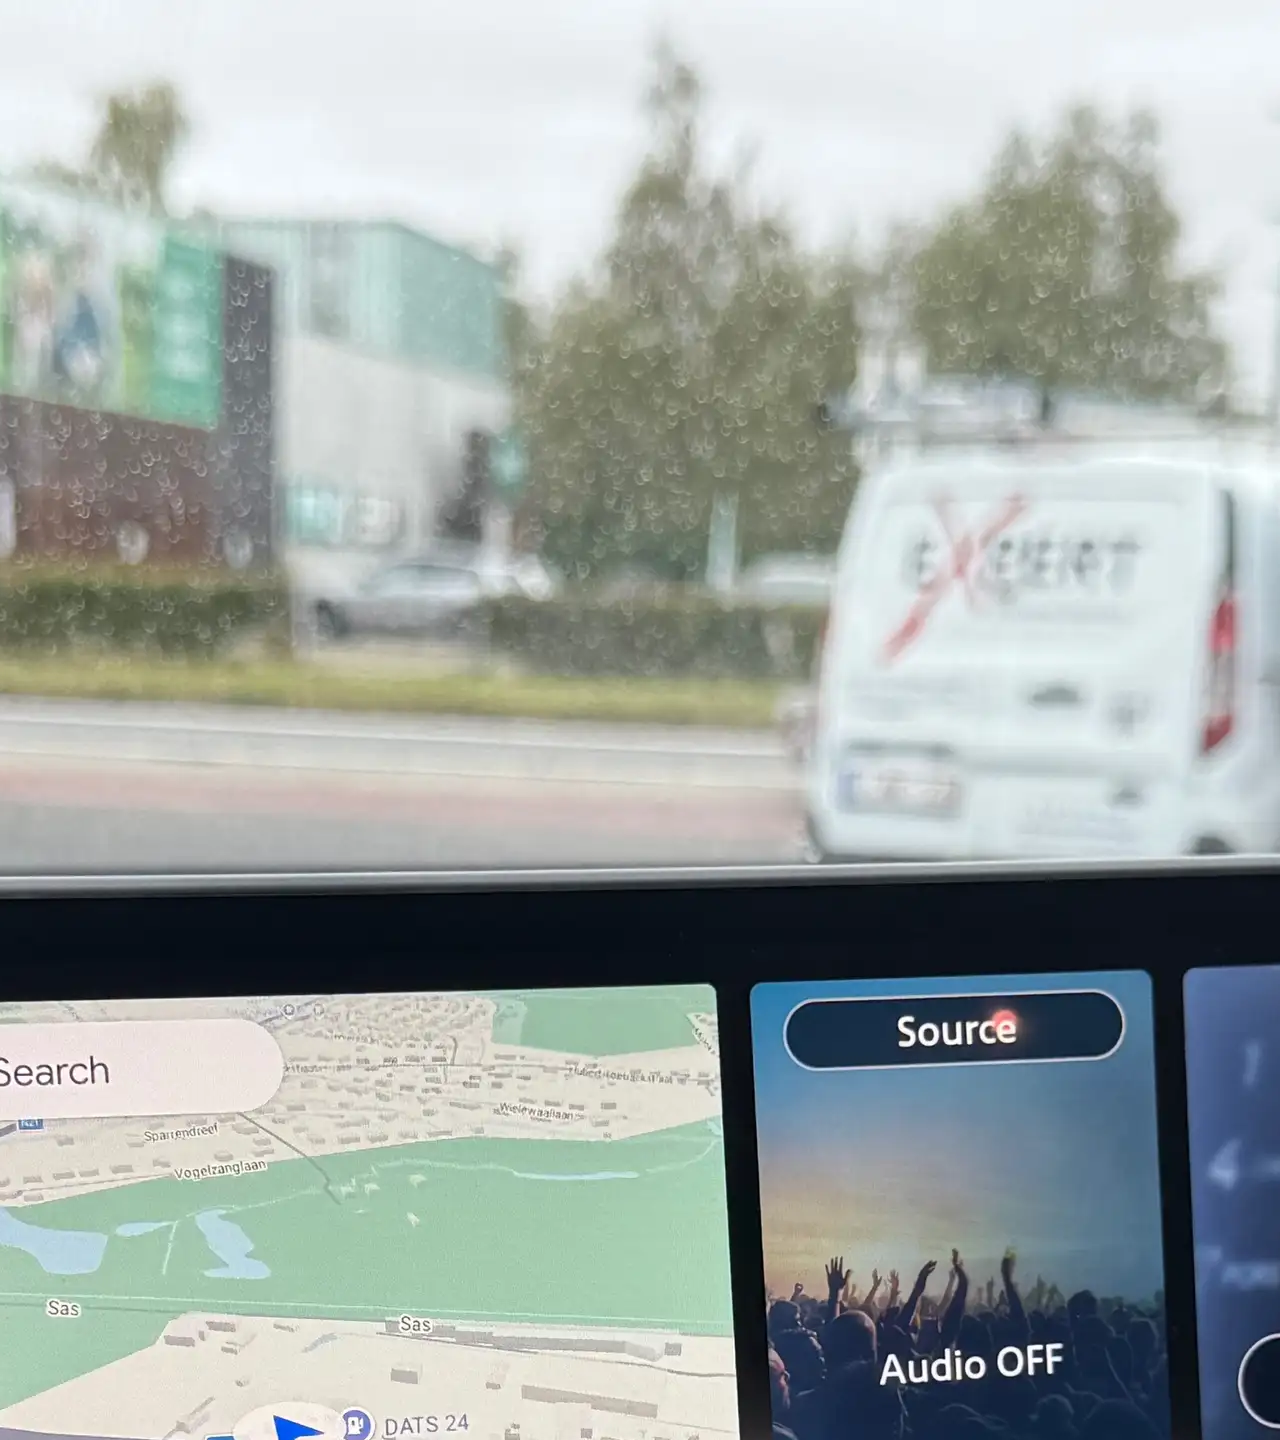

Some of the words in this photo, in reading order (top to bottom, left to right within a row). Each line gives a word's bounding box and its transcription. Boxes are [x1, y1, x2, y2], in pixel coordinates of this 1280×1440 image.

[897, 1015, 1018, 1048] Source
[47, 1299, 80, 1317] Sas
[400, 1315, 432, 1333] Sas
[879, 1347, 987, 1386] Audio
[996, 1342, 1064, 1378] OFF
[385, 1416, 439, 1436] DATS
[445, 1413, 469, 1432] 24
